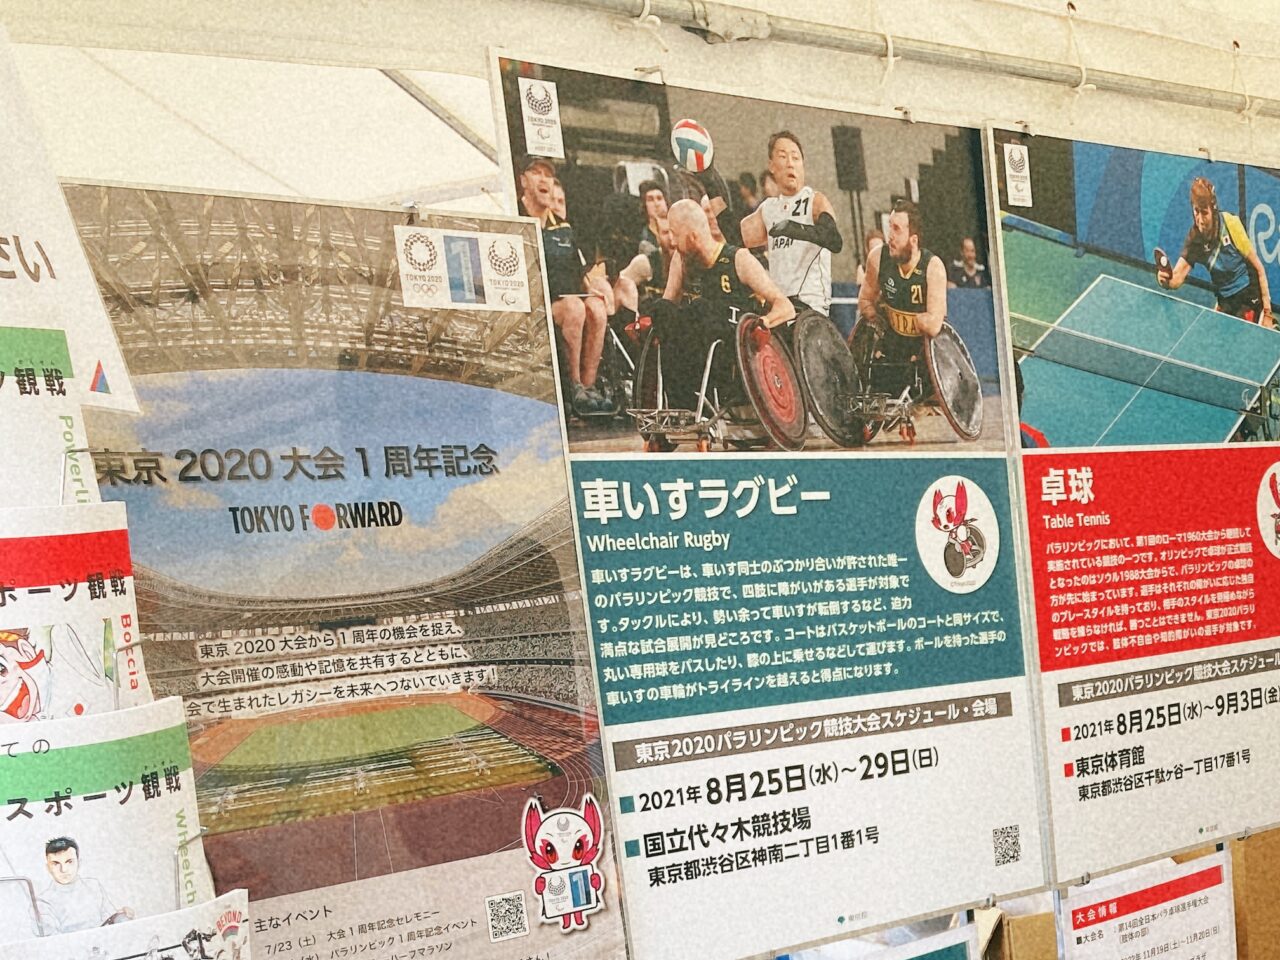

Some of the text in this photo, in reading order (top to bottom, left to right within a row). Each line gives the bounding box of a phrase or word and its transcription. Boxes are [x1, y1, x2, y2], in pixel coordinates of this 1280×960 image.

[791, 197, 809, 216] 21
[720, 275, 731, 293] 6
[911, 284, 923, 304] 21
[0, 366, 66, 396] 観戦
[580, 474, 831, 524] 車いすラグビー
[1041, 466, 1095, 506] 卓球
[229, 501, 404, 534] TOKYO FORWARD
[1043, 512, 1111, 529] Table Tennis
[586, 531, 731, 553] Wheelchair Rugby
[591, 555, 908, 585] 車いすラグビーは、車いす同士のぶつかり合いが許された唯一
[594, 574, 910, 608] のパラリンピック競技で、四肢に障がいがある選手が対象で
[120, 614, 139, 690] Boccia
[606, 663, 899, 707] 車いすの車輪がトライラインを越えると得点になります。
[634, 696, 998, 764] 東京2020パラリンピック競技大会スケジュール・会場
[1076, 745, 1146, 778] 東京体育館
[6, 765, 182, 821] スポーツ観戦
[643, 806, 812, 858] 国立代々木競技場
[647, 825, 880, 888] 東京都渋谷区神南二丁目1番1号
[216, 909, 242, 931] BEYOND
[254, 905, 334, 934] 主なイベント
[1076, 902, 1118, 924] 大会情報
[1083, 930, 1104, 943] 大会名
